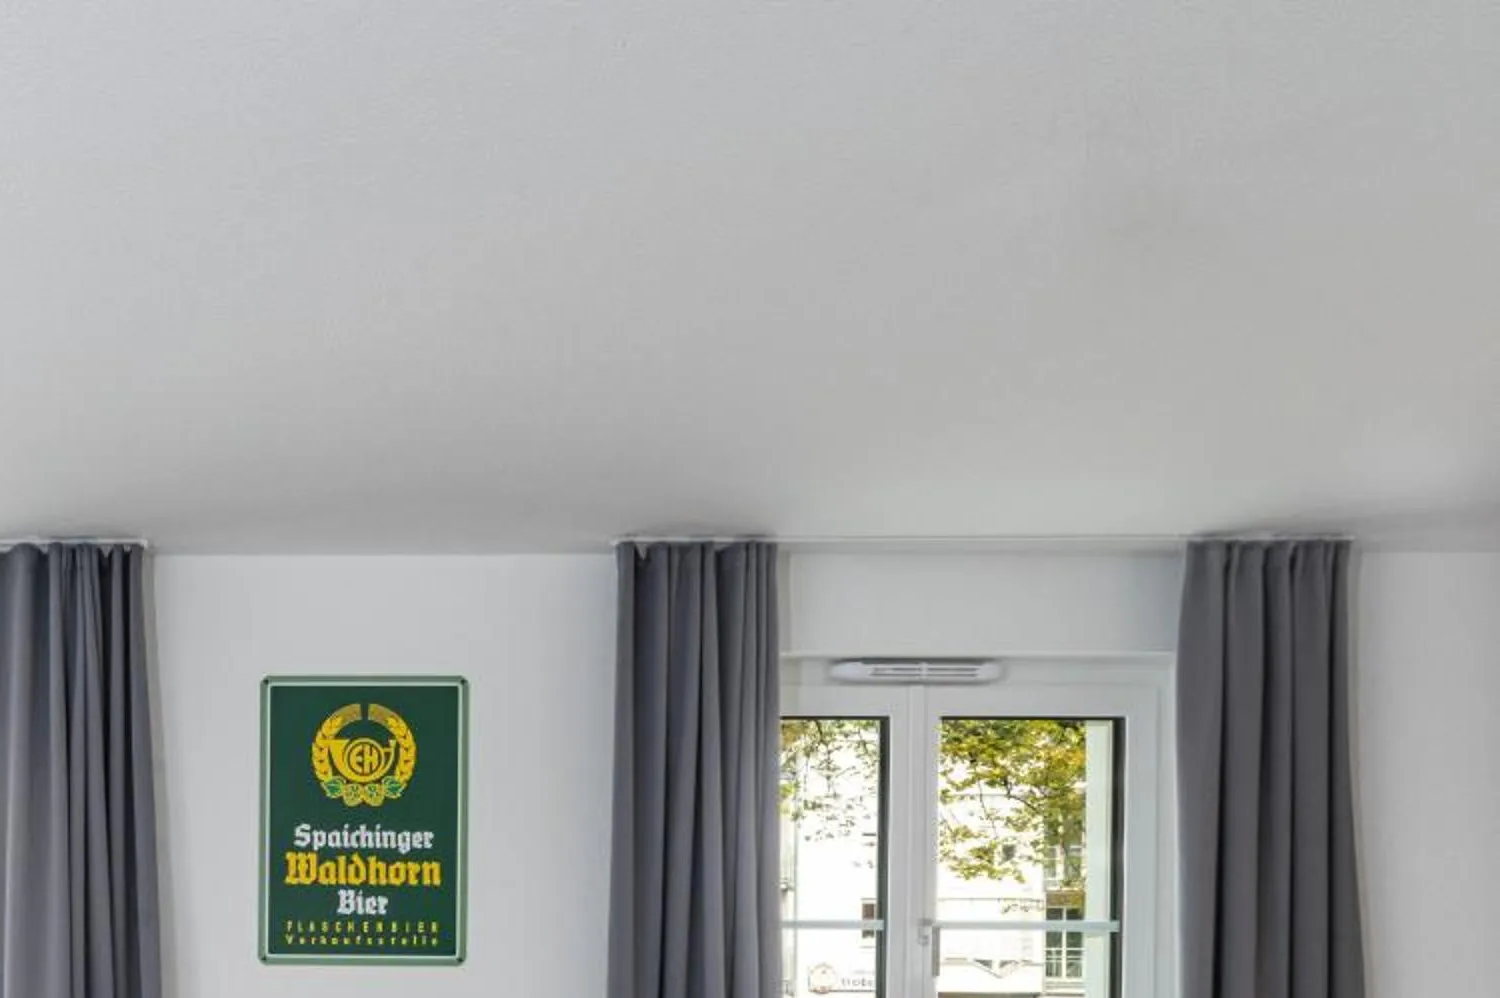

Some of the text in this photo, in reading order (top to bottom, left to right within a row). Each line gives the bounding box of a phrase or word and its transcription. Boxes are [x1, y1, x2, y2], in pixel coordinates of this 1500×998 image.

[294, 823, 434, 854] Spaichinger
[284, 852, 441, 886] Waldhorn
[337, 889, 389, 915] Bier
[286, 920, 438, 933] FLASCHENBIER
